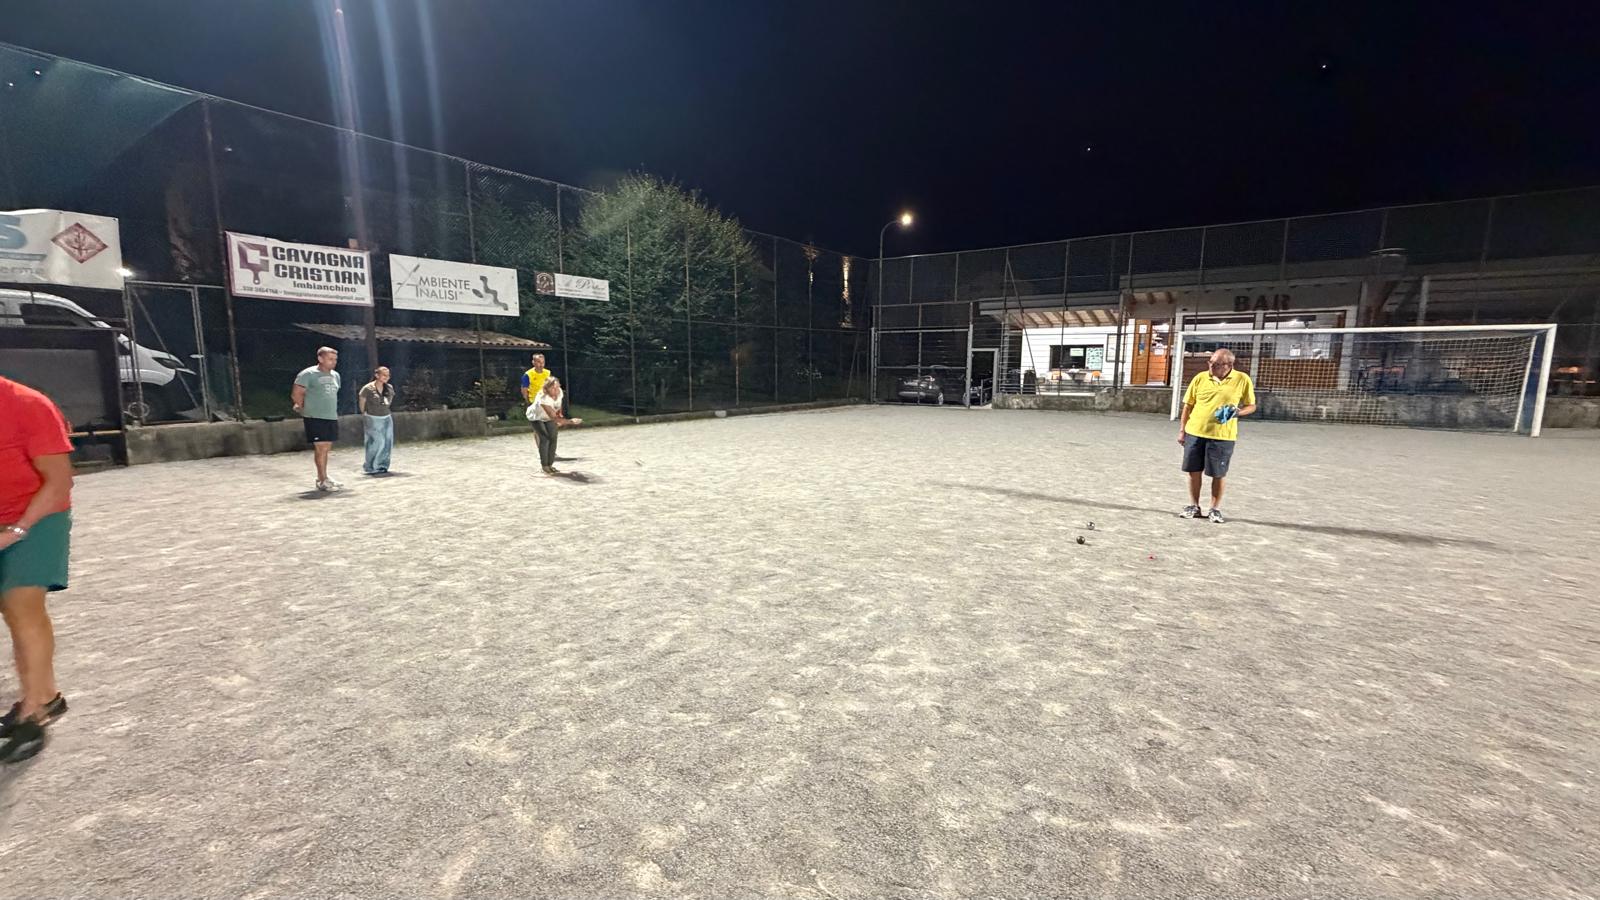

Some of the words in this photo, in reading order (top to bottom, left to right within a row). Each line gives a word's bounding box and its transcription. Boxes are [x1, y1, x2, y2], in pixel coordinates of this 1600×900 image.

[272, 246, 364, 269] CAVAGNA
[274, 263, 366, 286] CRISTIAN
[293, 280, 357, 293] Imbianchino
[1233, 294, 1291, 313] BAR
